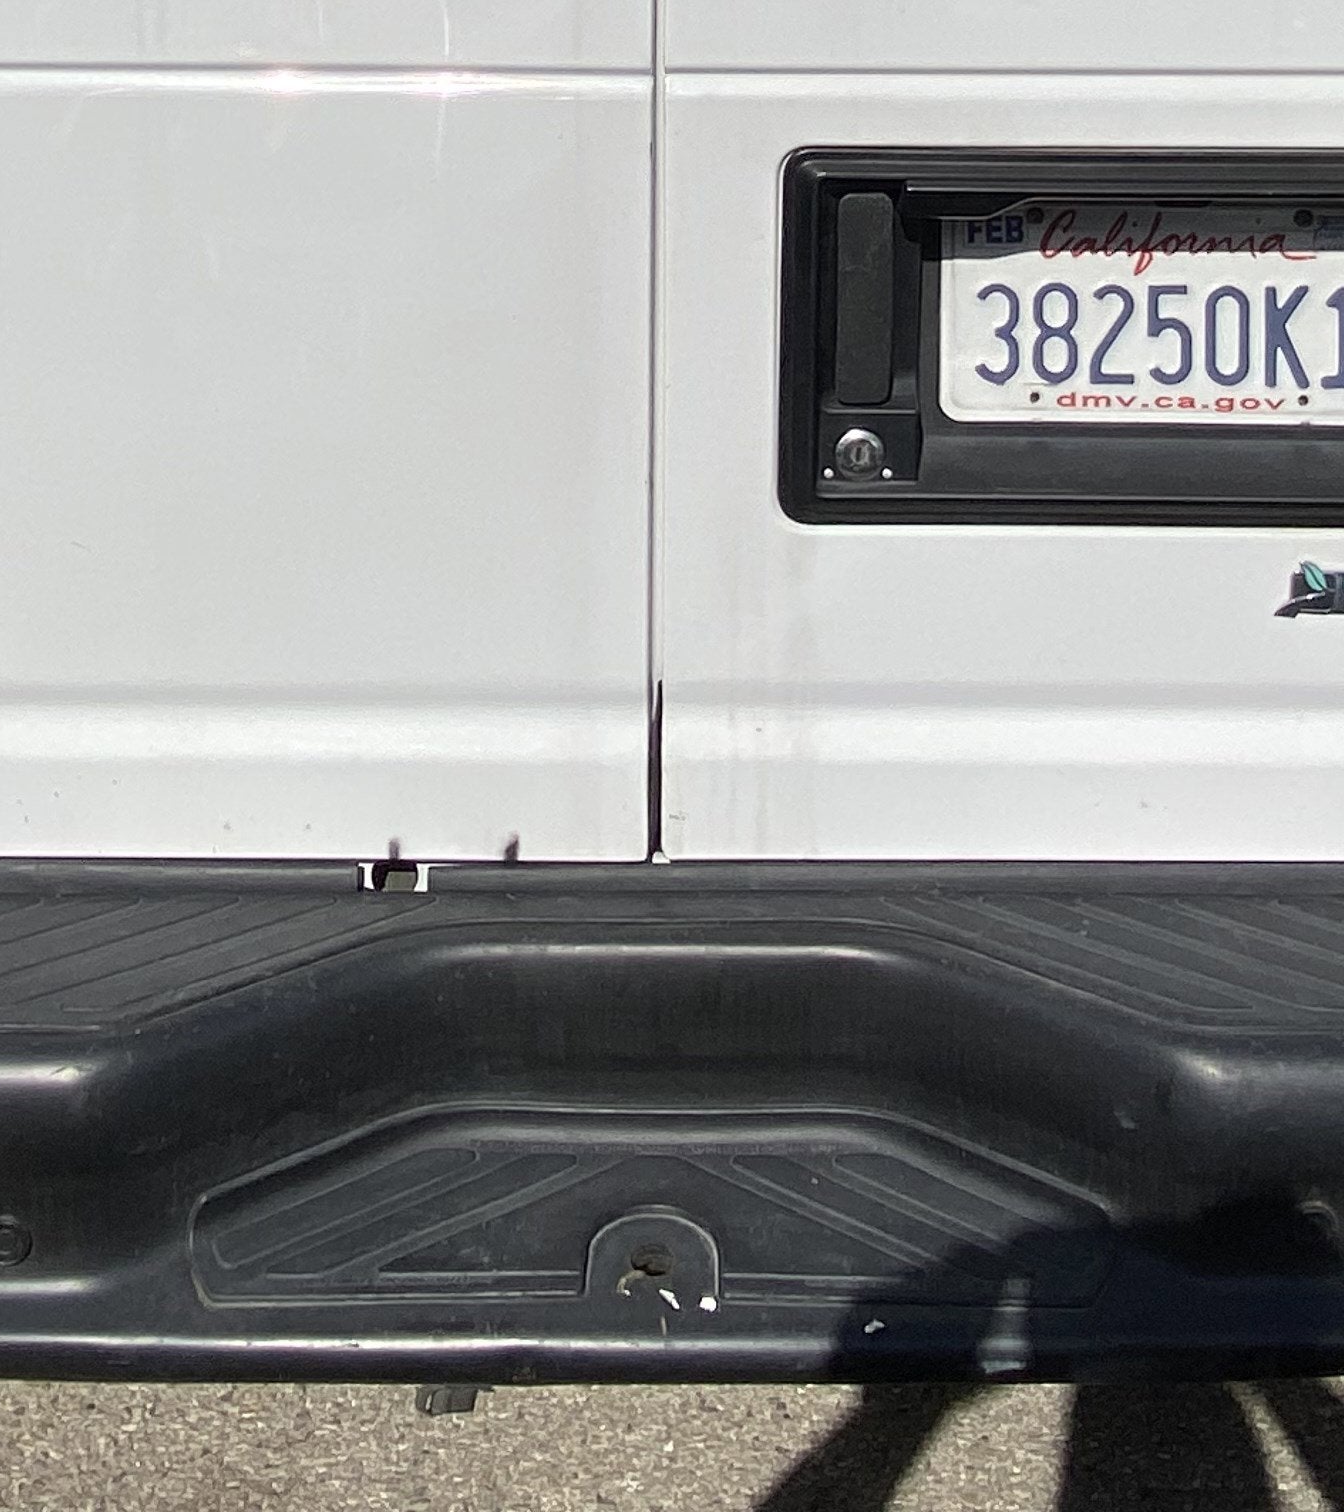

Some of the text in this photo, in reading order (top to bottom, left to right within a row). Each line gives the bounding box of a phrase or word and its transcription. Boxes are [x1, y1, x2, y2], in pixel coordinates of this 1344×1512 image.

[967, 214, 1025, 245] FEB
[1038, 208, 1317, 277] California
[1056, 391, 1288, 413] dmv.ca.gov
